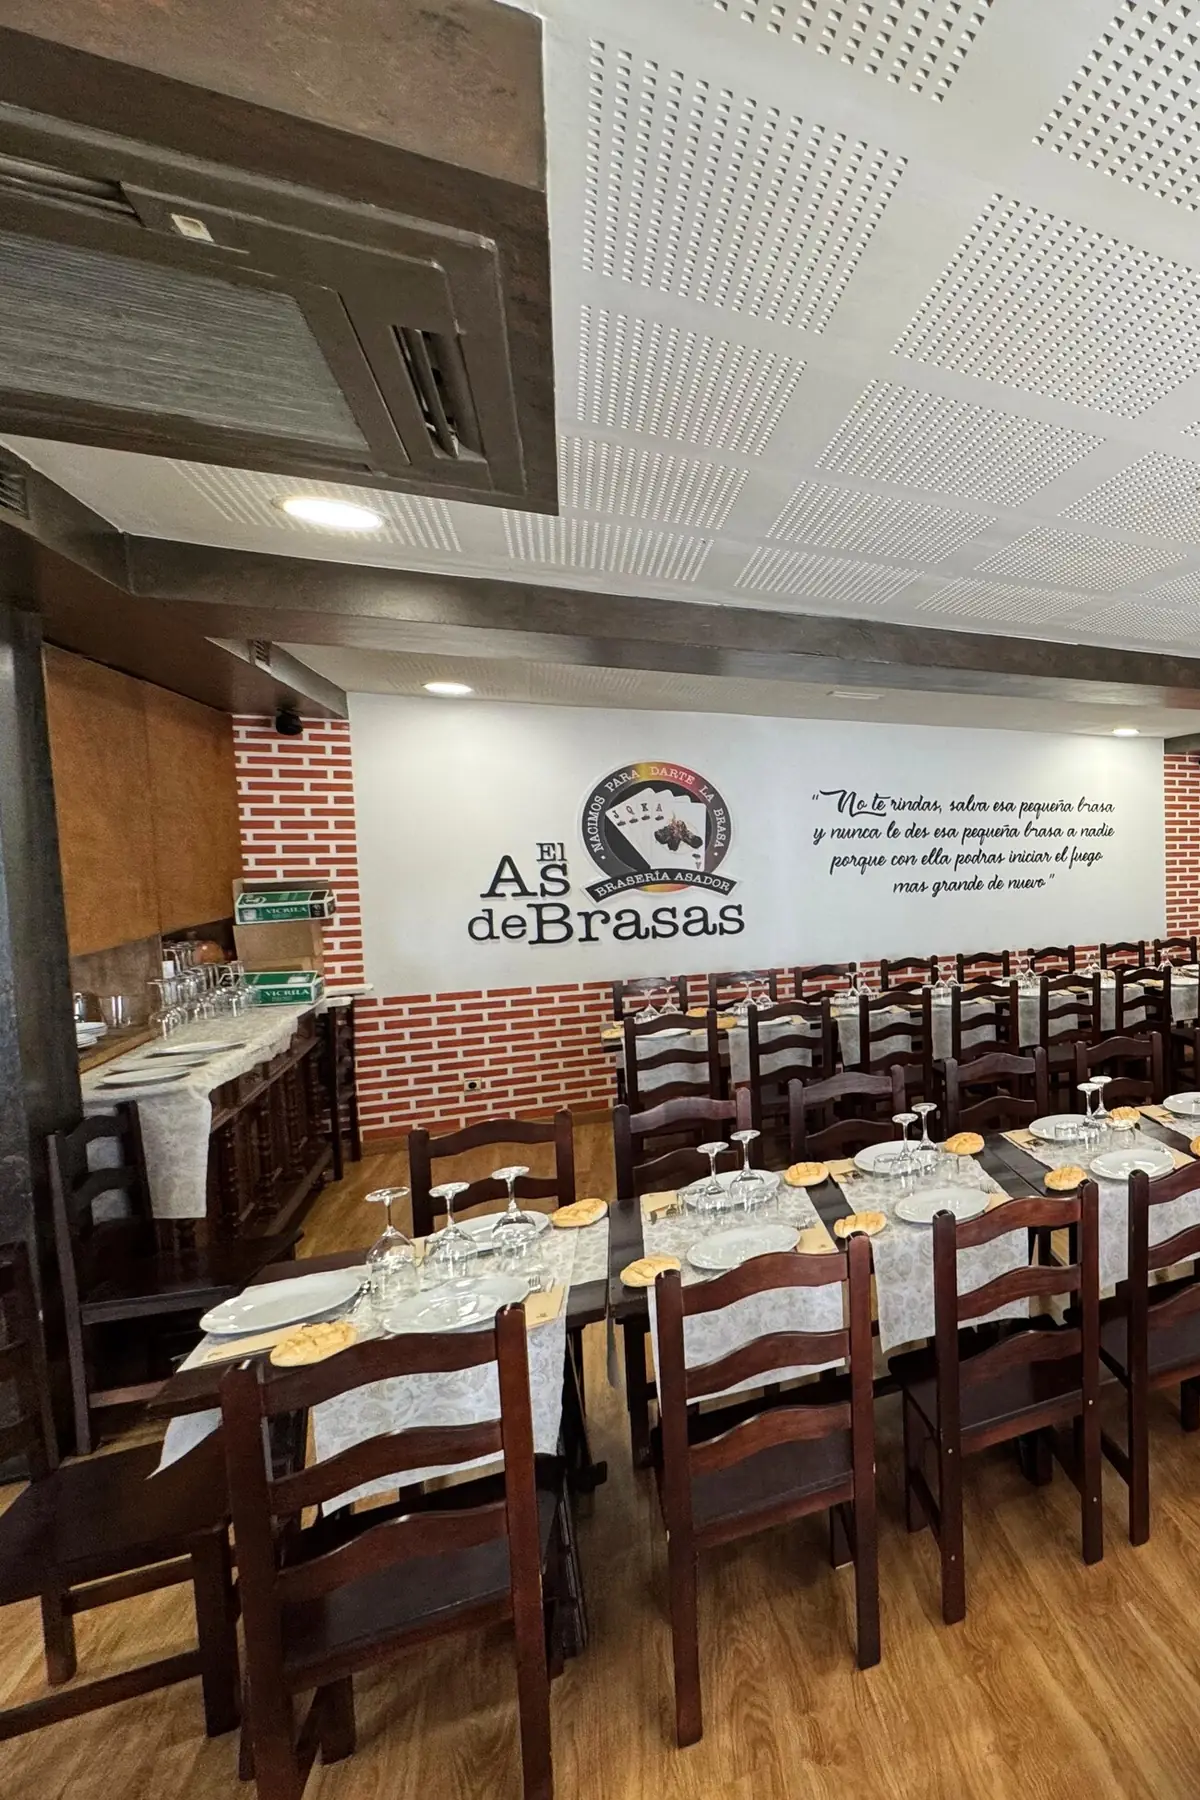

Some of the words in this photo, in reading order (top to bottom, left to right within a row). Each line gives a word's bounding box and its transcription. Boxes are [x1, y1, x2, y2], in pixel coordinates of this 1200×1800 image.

[586, 795, 606, 853] NACIMOS
[604, 769, 641, 793] PARA
[649, 766, 696, 785] DARTE
[698, 785, 716, 803] LA
[713, 808, 727, 848] BRASA
[871, 792, 892, 811] te
[891, 794, 942, 814] rindas,
[949, 794, 990, 812] salva
[992, 800, 1017, 812] esa
[1018, 800, 1074, 820] pequeña
[1077, 796, 1115, 813] brasa
[812, 827, 827, 845] y
[830, 827, 882, 839] nunca
[886, 820, 901, 839] le
[904, 821, 930, 839] des
[933, 827, 960, 839] esa
[961, 824, 1020, 846] pequeña
[1023, 821, 1064, 838] brasa
[1066, 827, 1078, 838] a
[1080, 822, 1115, 838] nadie
[536, 842, 568, 862] El
[829, 854, 887, 875] porque
[890, 853, 918, 866] con
[920, 847, 952, 866] ella
[953, 848, 1006, 872] podras
[1008, 850, 1053, 864] iniciar
[1054, 846, 1069, 863] el
[1068, 846, 1104, 870] fuego
[594, 870, 671, 898] BRASERÍA
[674, 871, 732, 893] ASADOR
[892, 881, 929, 893] mas
[932, 874, 985, 898] grande
[987, 874, 1005, 891] de
